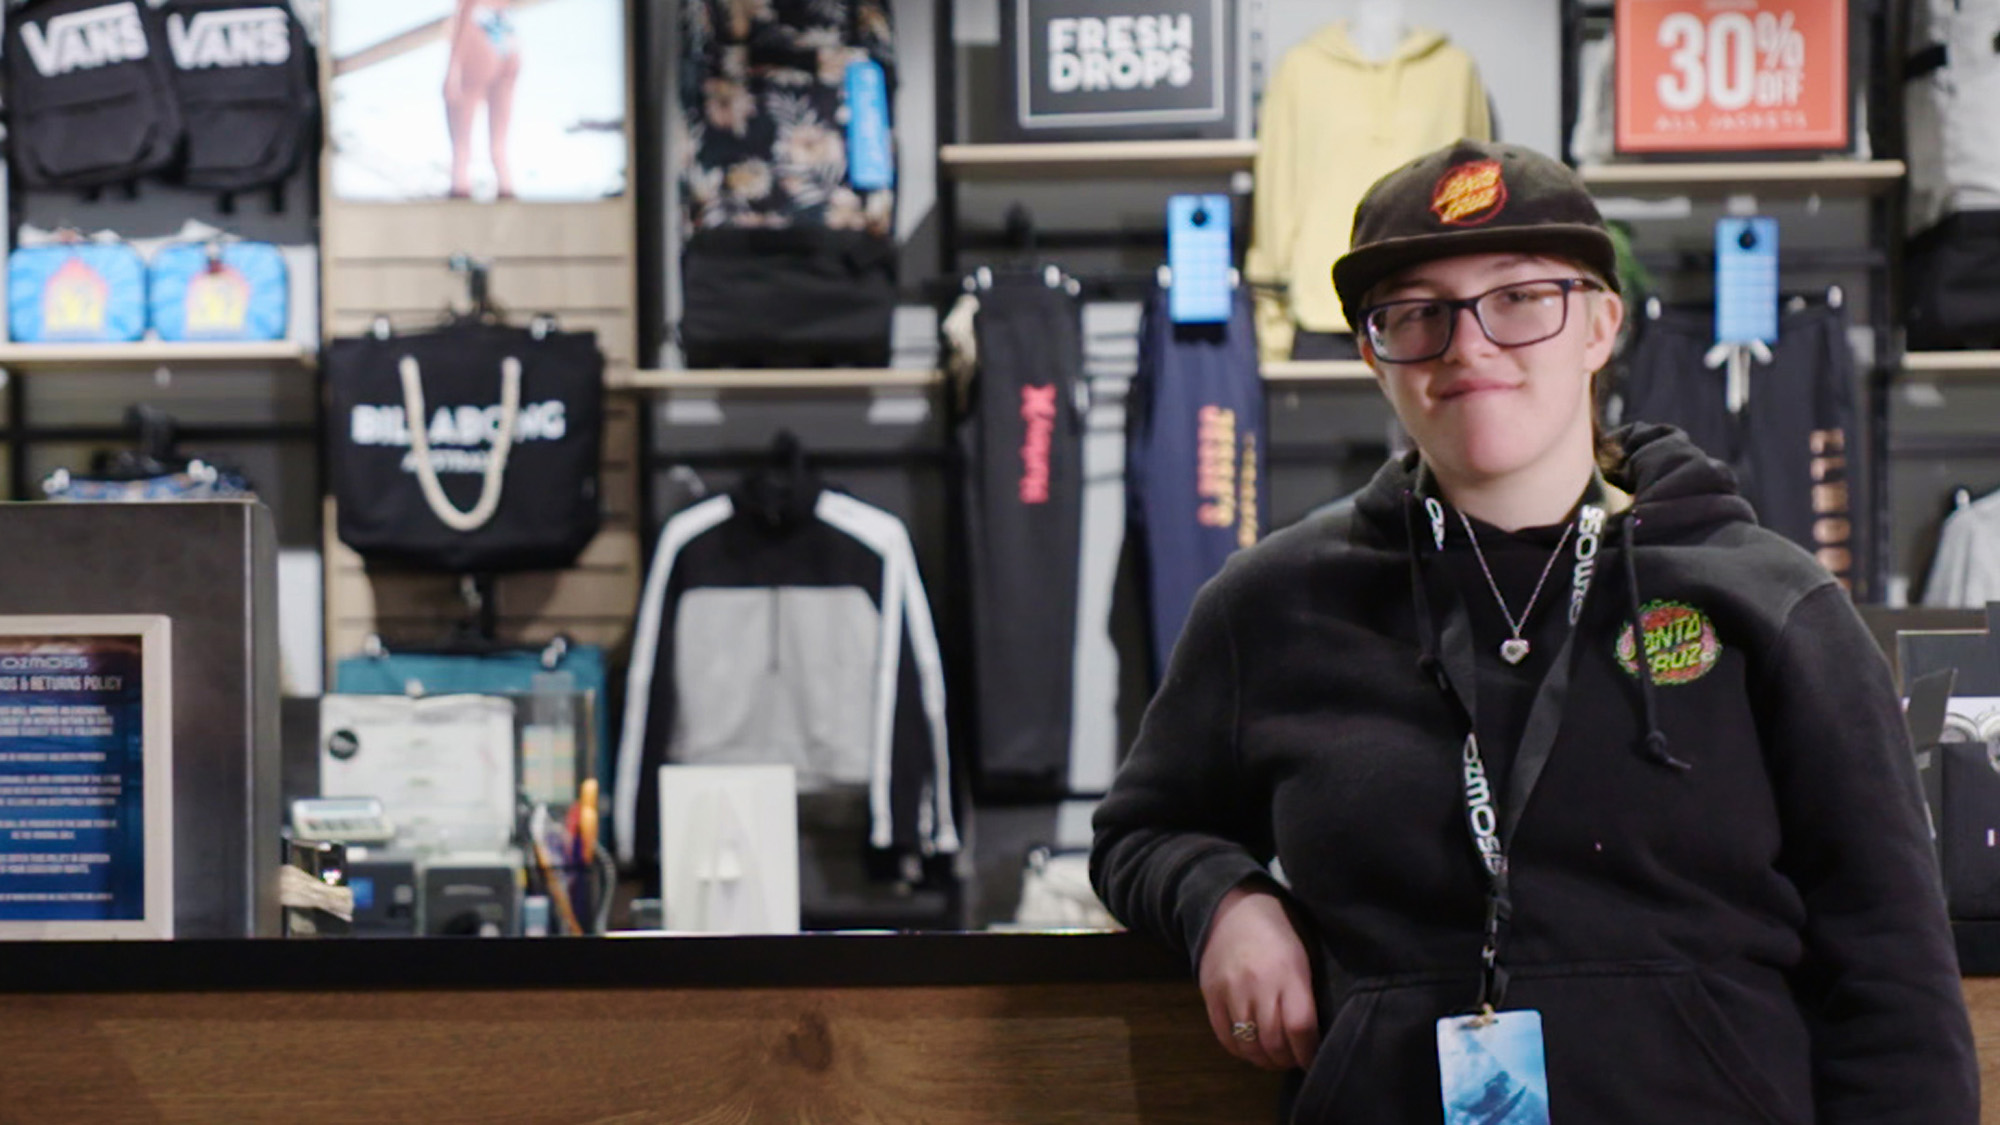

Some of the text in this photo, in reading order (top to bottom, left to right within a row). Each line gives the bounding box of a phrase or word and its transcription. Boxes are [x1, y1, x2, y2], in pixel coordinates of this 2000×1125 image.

[19, 1, 149, 77] VANS
[166, 7, 291, 70] VANS
[1048, 13, 1193, 51] FRESH
[1048, 48, 1193, 93] DROPS
[1755, 69, 1804, 107] OFF
[1655, 110, 1807, 131] ALL JACKETS
[352, 400, 566, 445] BILABONG
[84, 675, 123, 691] POLICY
